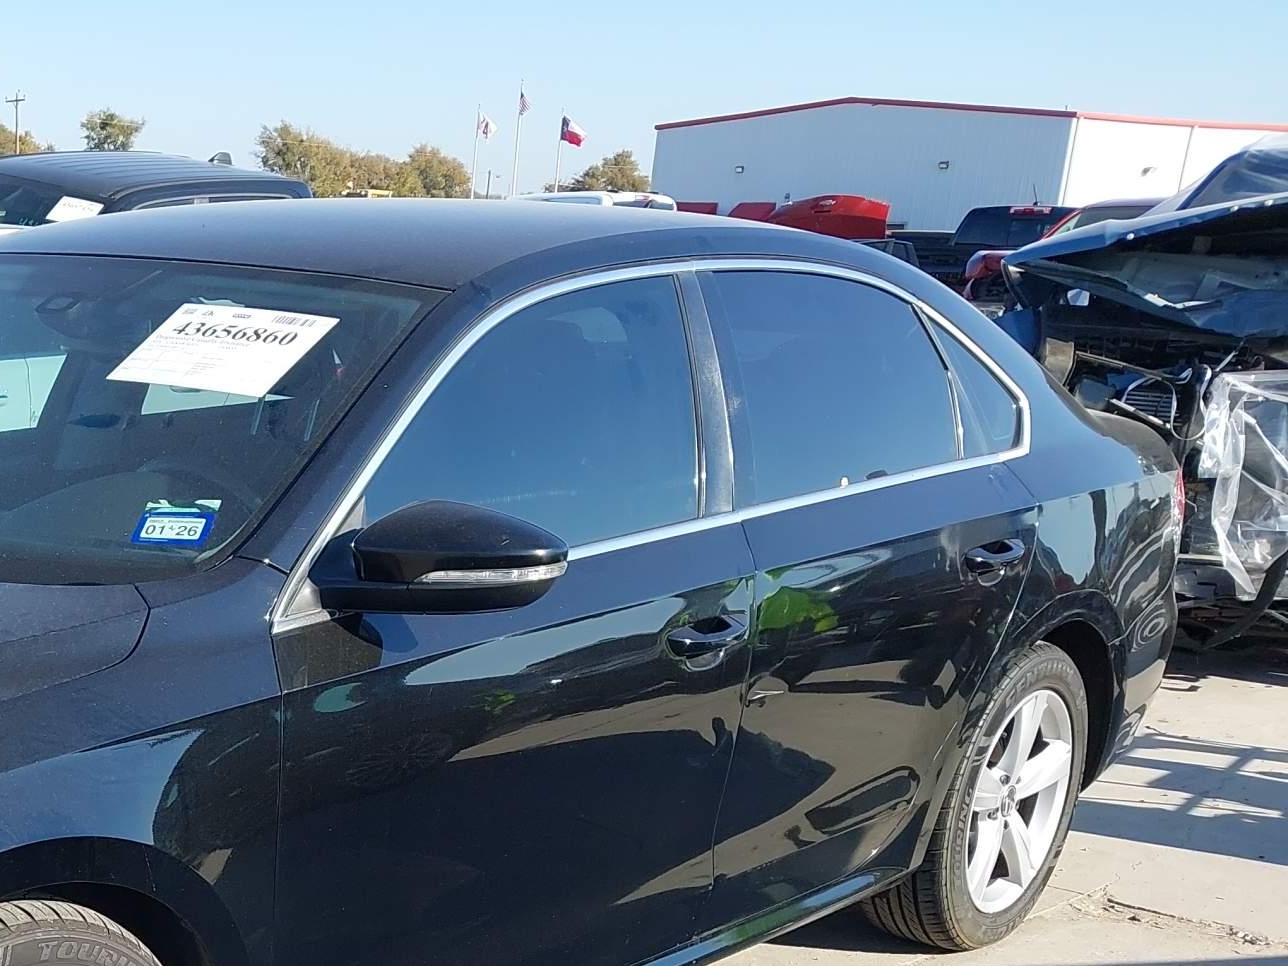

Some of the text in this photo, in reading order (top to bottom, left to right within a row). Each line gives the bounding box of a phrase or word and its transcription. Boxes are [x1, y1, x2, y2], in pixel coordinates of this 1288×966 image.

[172, 320, 299, 346] 43656860
[145, 524, 200, 537] 01 26
